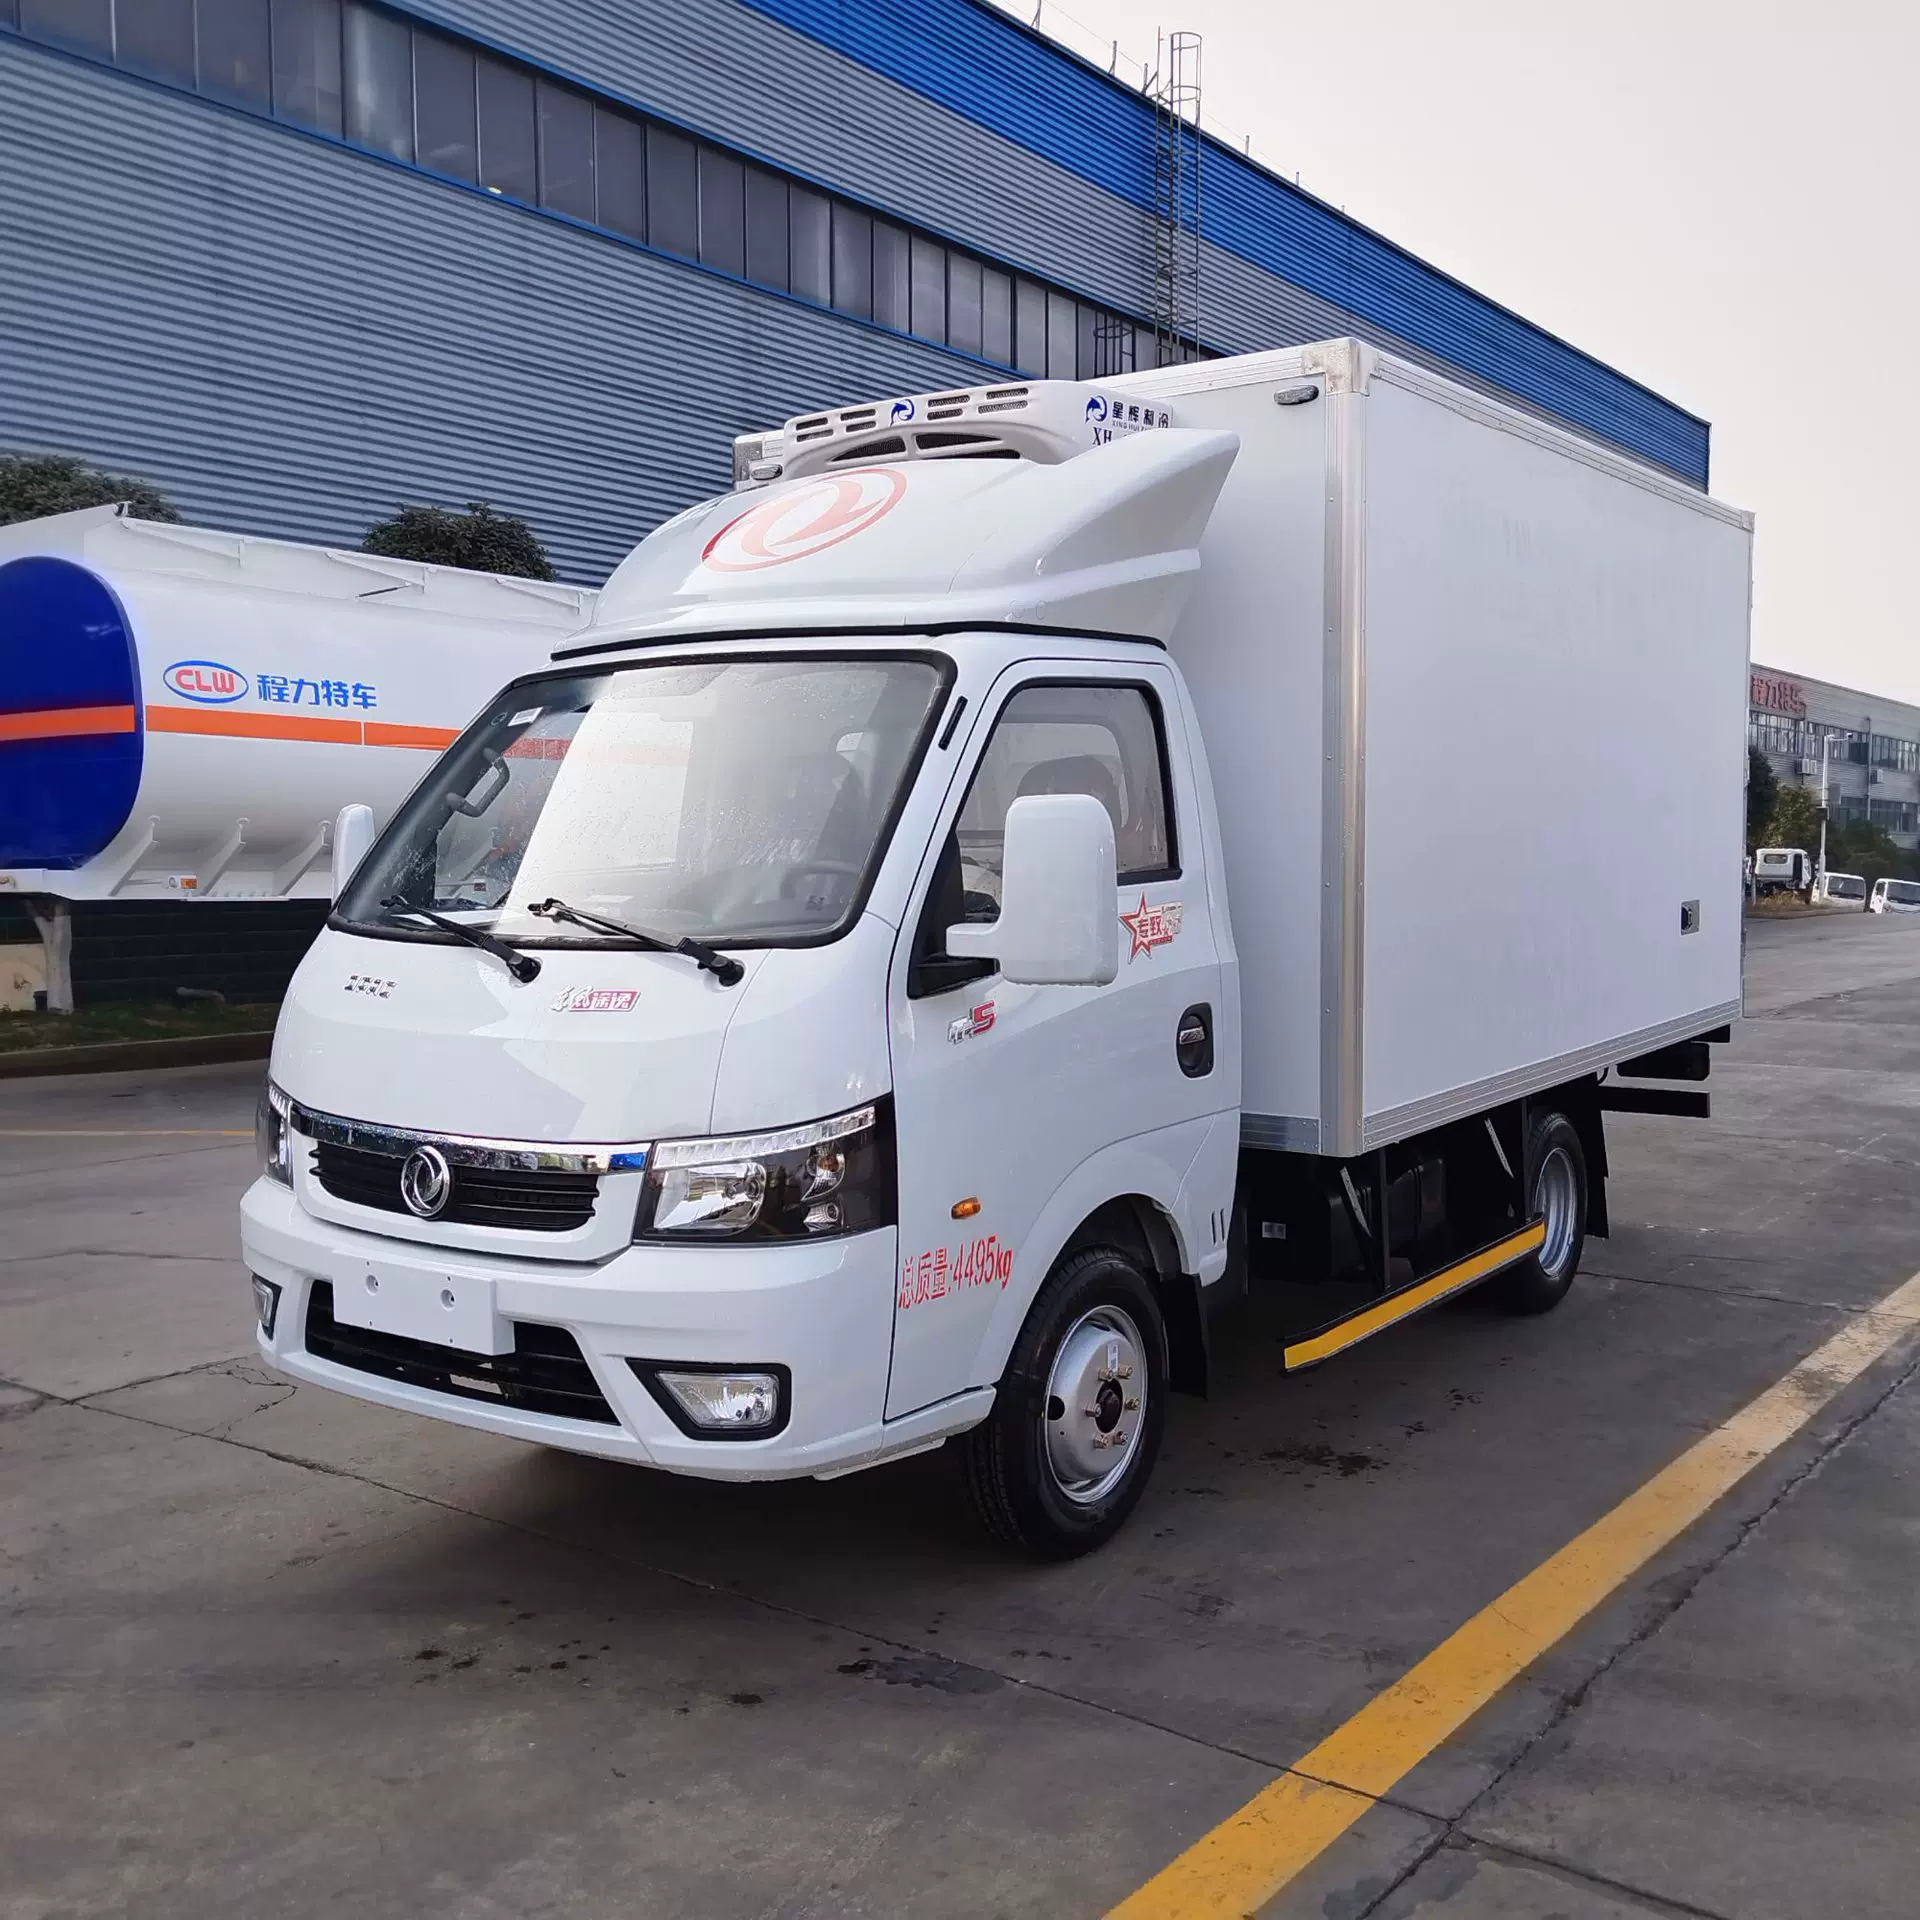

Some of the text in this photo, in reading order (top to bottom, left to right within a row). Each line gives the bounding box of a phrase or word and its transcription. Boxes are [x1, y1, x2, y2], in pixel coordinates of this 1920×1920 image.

[1112, 401, 1169, 429] 星辉制冷
[175, 669, 235, 694] CLW
[257, 674, 377, 709] 程力特车
